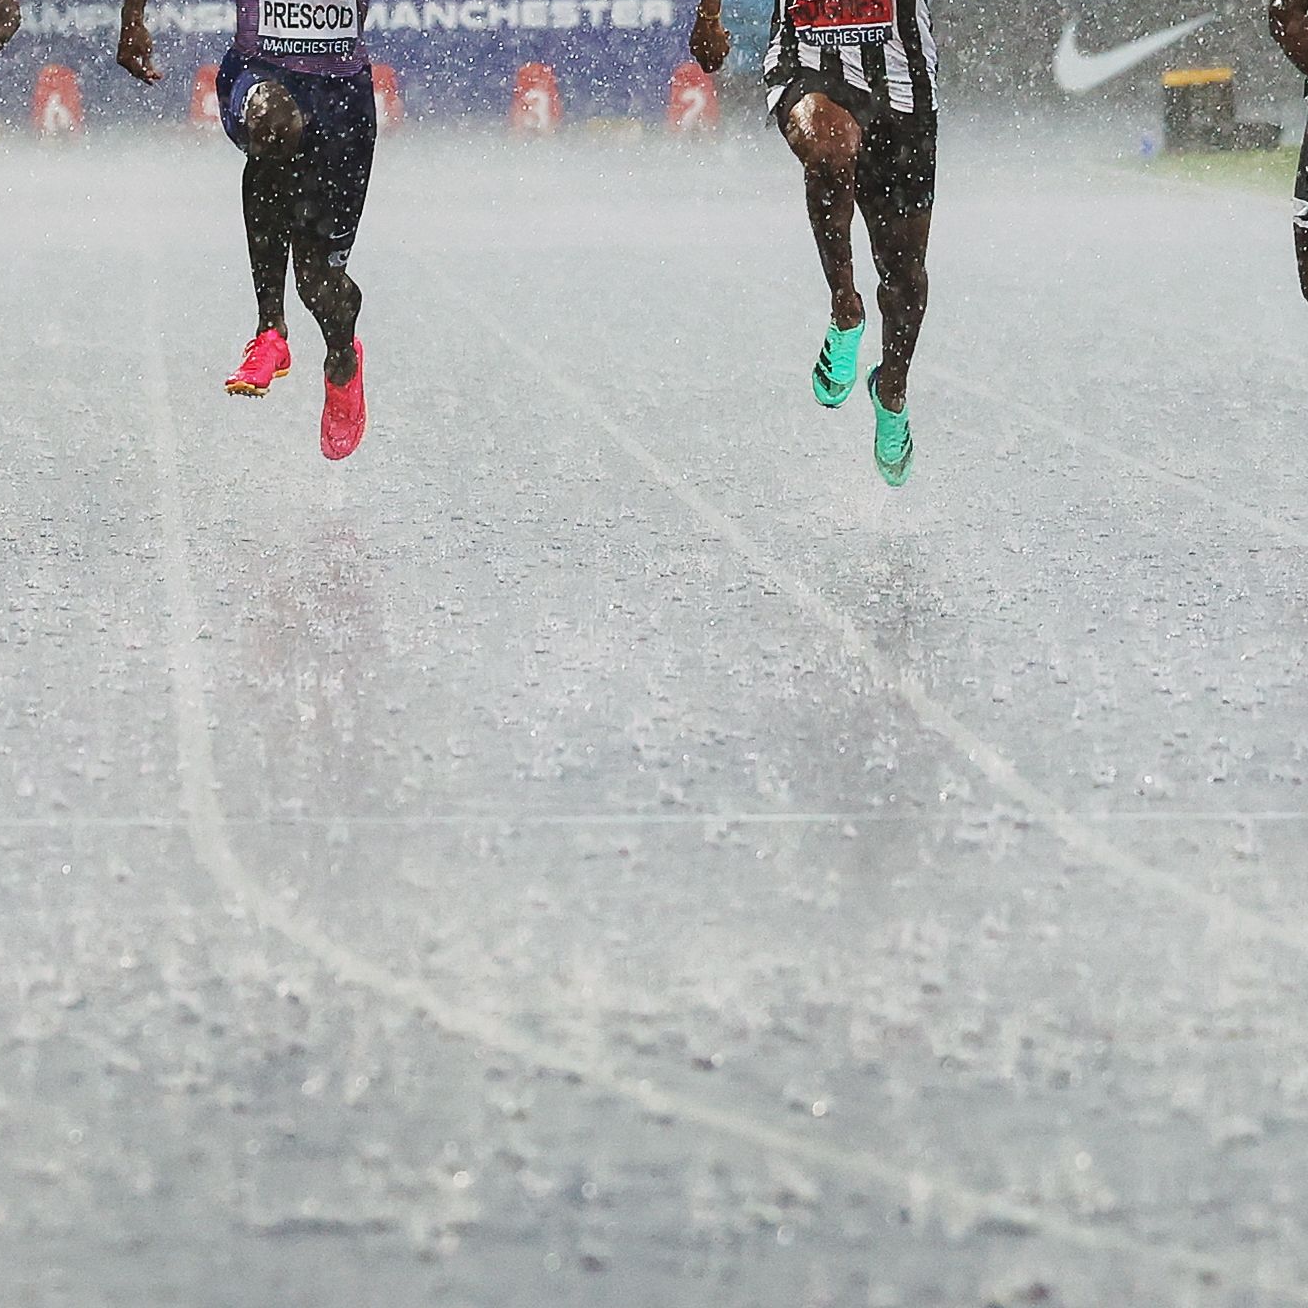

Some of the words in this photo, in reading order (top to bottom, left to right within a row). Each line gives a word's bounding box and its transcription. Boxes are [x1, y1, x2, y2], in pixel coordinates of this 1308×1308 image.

[263, 0, 354, 30] PRESCOD
[262, 38, 350, 54] MANCHESTER
[680, 89, 707, 129] 2
